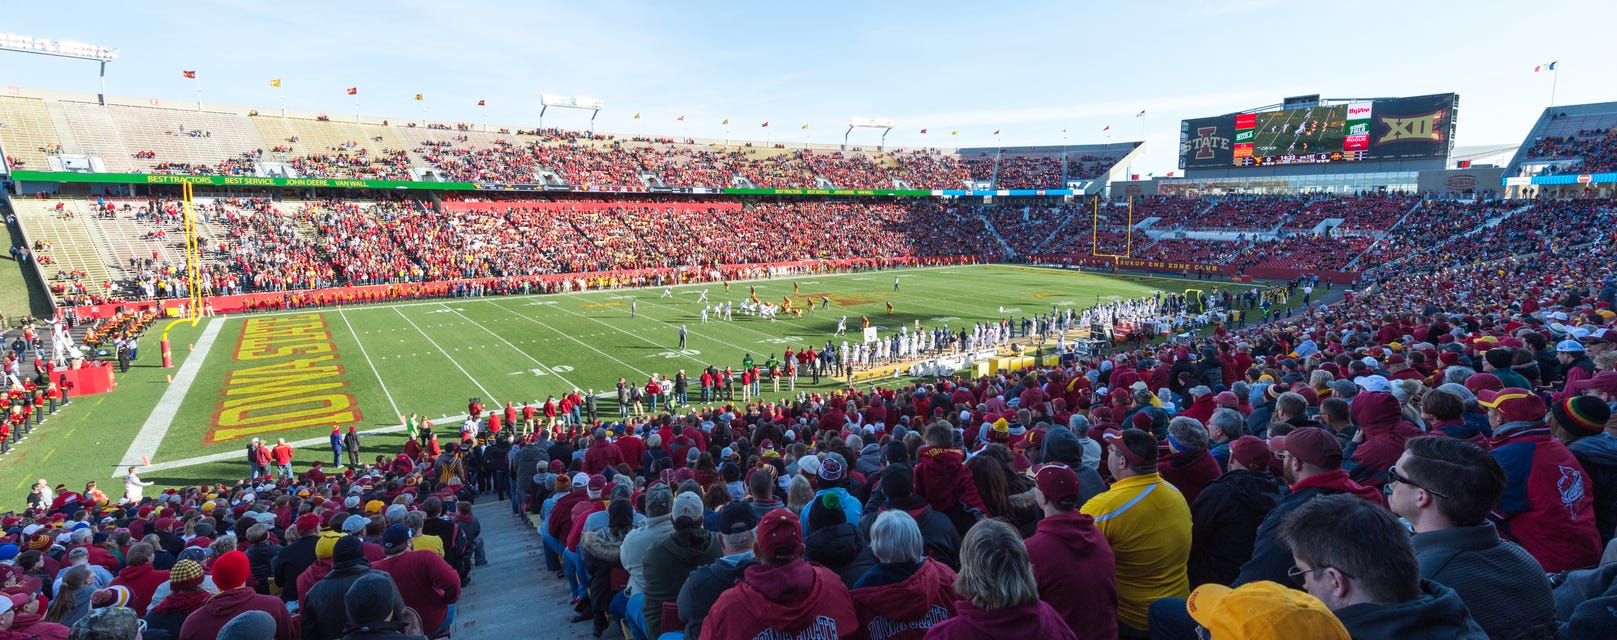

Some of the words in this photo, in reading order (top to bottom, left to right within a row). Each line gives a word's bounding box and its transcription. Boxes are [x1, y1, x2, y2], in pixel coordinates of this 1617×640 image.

[1379, 112, 1442, 143] XII
[1184, 136, 1230, 152] STATE
[148, 175, 168, 183] BEST
[169, 176, 214, 184] TRACTORS.
[232, 313, 337, 361] STATE
[527, 365, 575, 377] 10
[202, 353, 364, 446] IOWA
